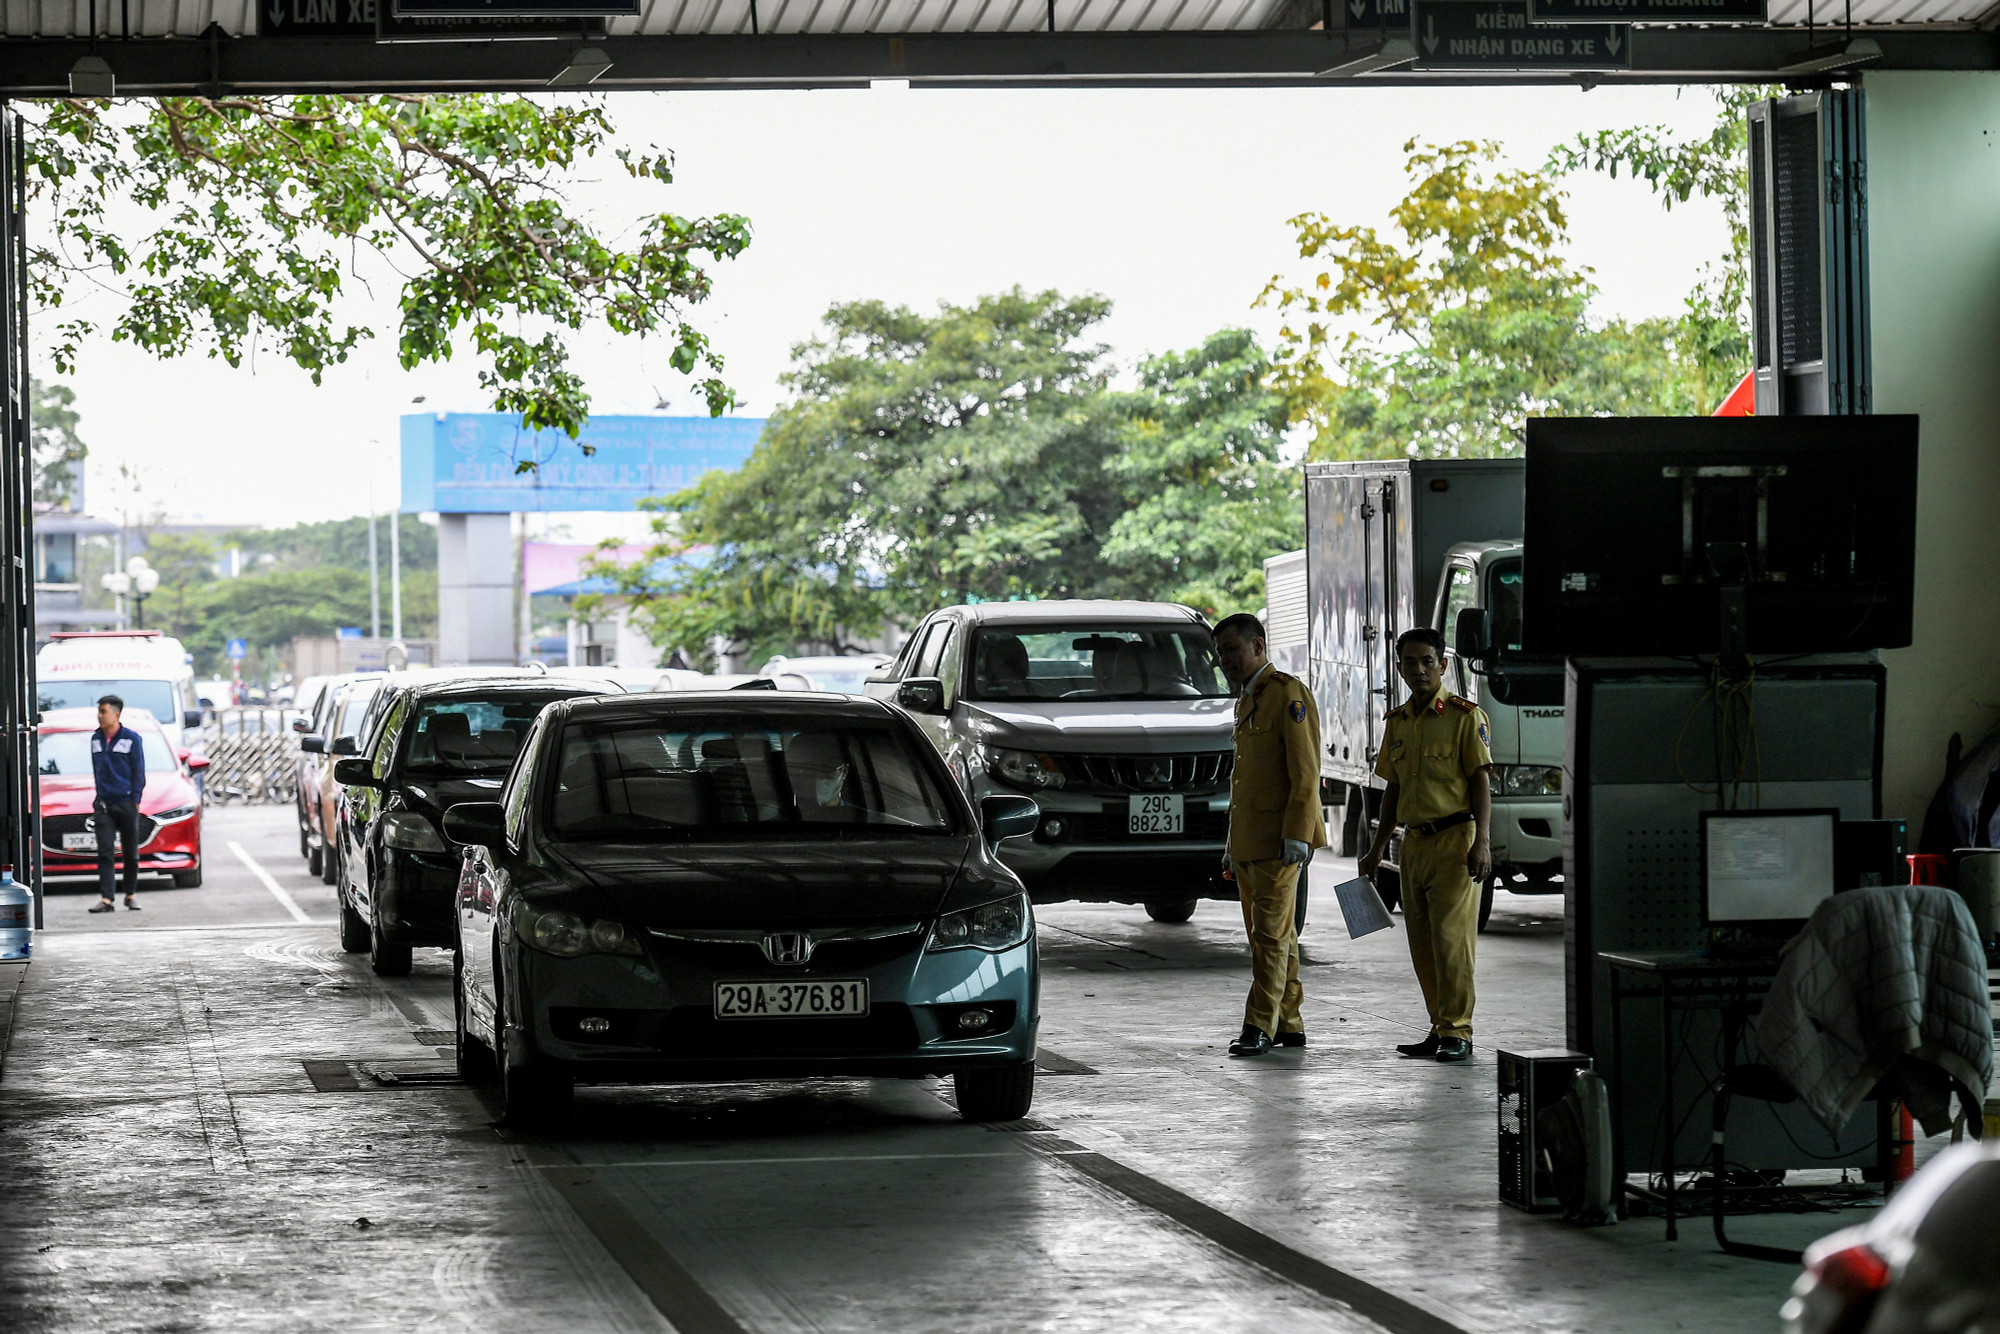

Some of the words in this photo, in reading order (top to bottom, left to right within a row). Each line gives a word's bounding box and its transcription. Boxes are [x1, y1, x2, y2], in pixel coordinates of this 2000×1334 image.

[1475, 4, 1525, 29] KIỂM
[1450, 36, 1504, 59] NHẬN
[1511, 39, 1565, 59] DẠNG
[1570, 39, 1595, 56] XE
[1142, 796, 1171, 814] 29C
[1130, 814, 1181, 832] 882.31
